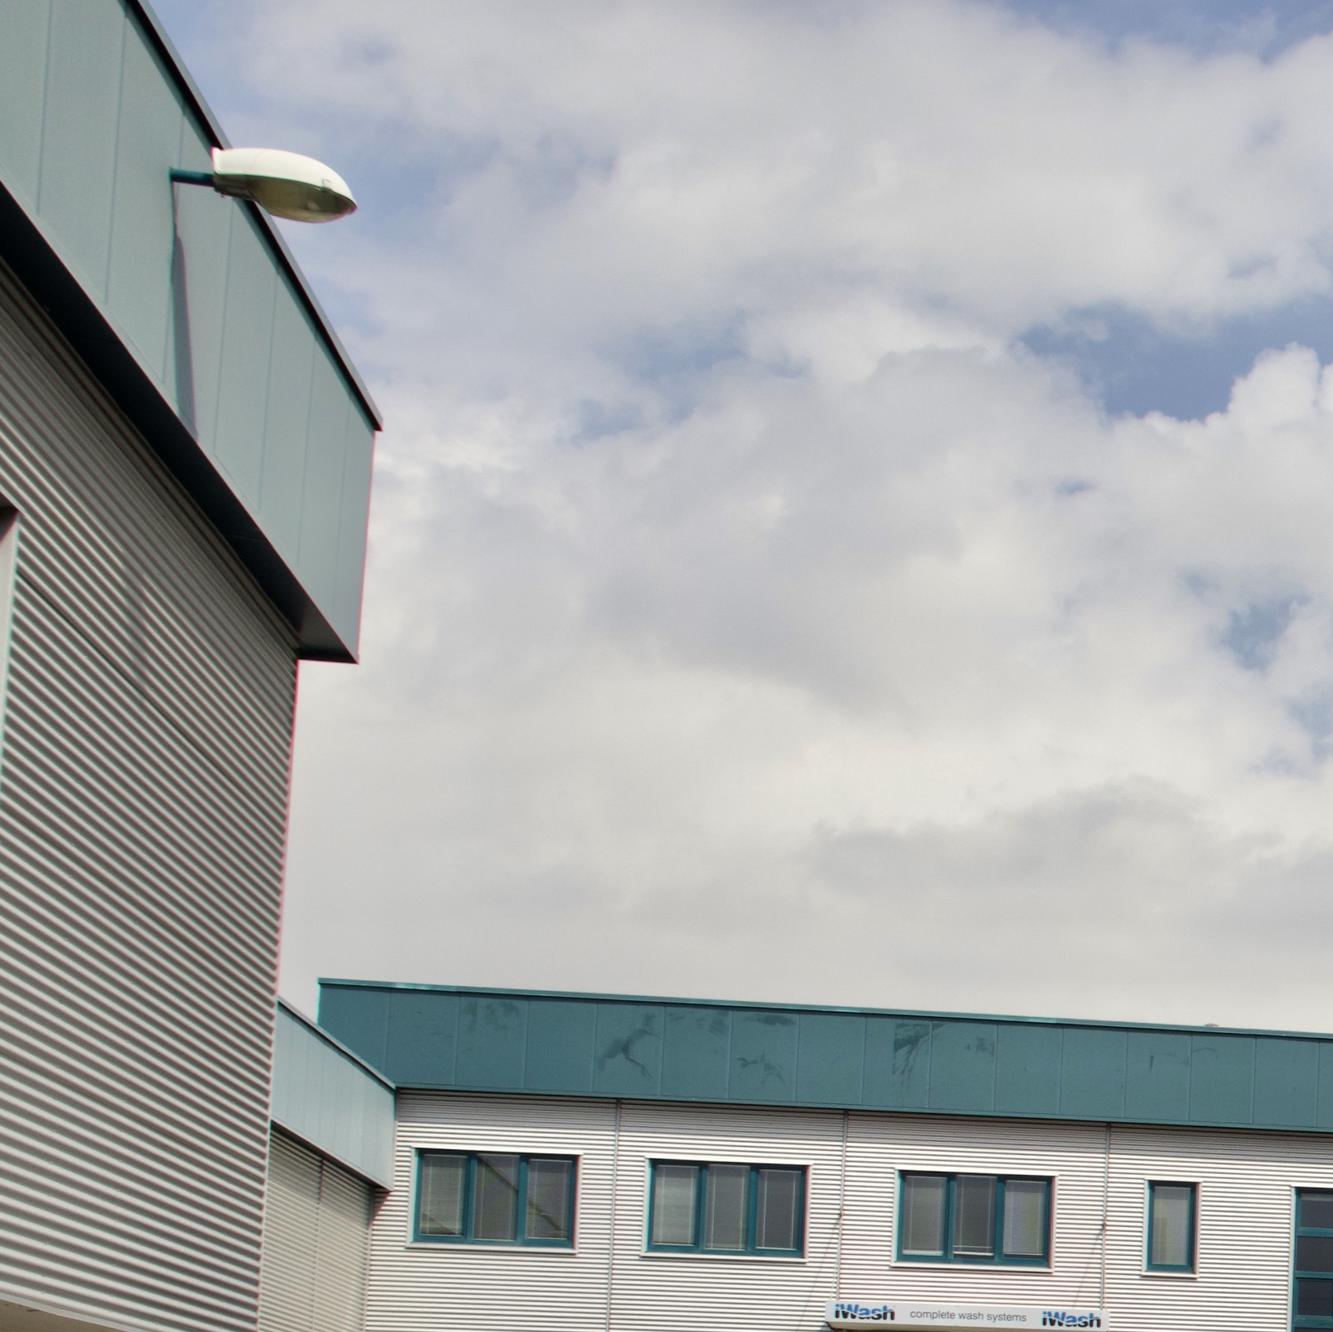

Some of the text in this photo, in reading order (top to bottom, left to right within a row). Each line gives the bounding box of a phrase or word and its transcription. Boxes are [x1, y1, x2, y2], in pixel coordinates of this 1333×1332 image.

[834, 1303, 1101, 1328] iWash complete wash systems iWash
